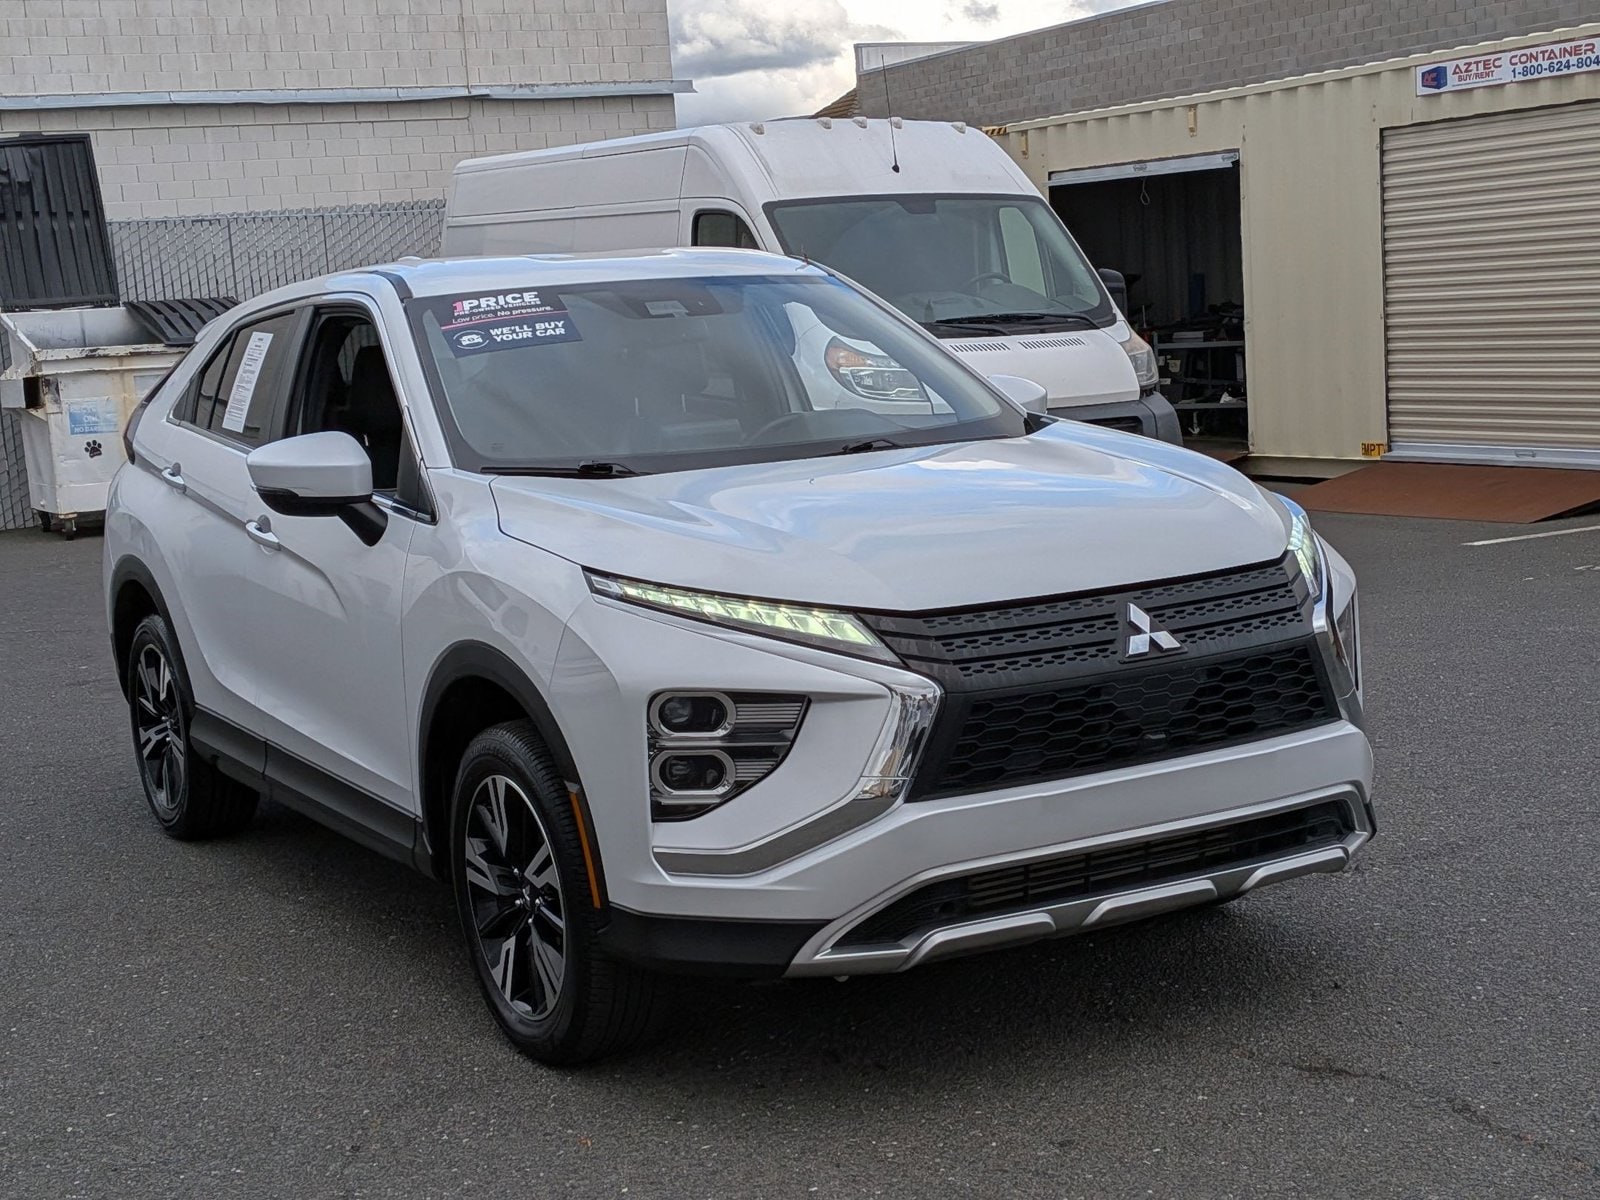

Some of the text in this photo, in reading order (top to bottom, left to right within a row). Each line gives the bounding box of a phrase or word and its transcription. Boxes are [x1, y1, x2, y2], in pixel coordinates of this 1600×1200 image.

[1451, 43, 1596, 76] AZTEC CONTAINER
[1457, 71, 1495, 83] BUY/RENT
[452, 305, 554, 324] Low price. No pressure.
[454, 301, 541, 316] PRE-OWNED VEHICLES
[489, 320, 565, 336] WE'LL BUY
[492, 327, 565, 342] YOUR CAR
